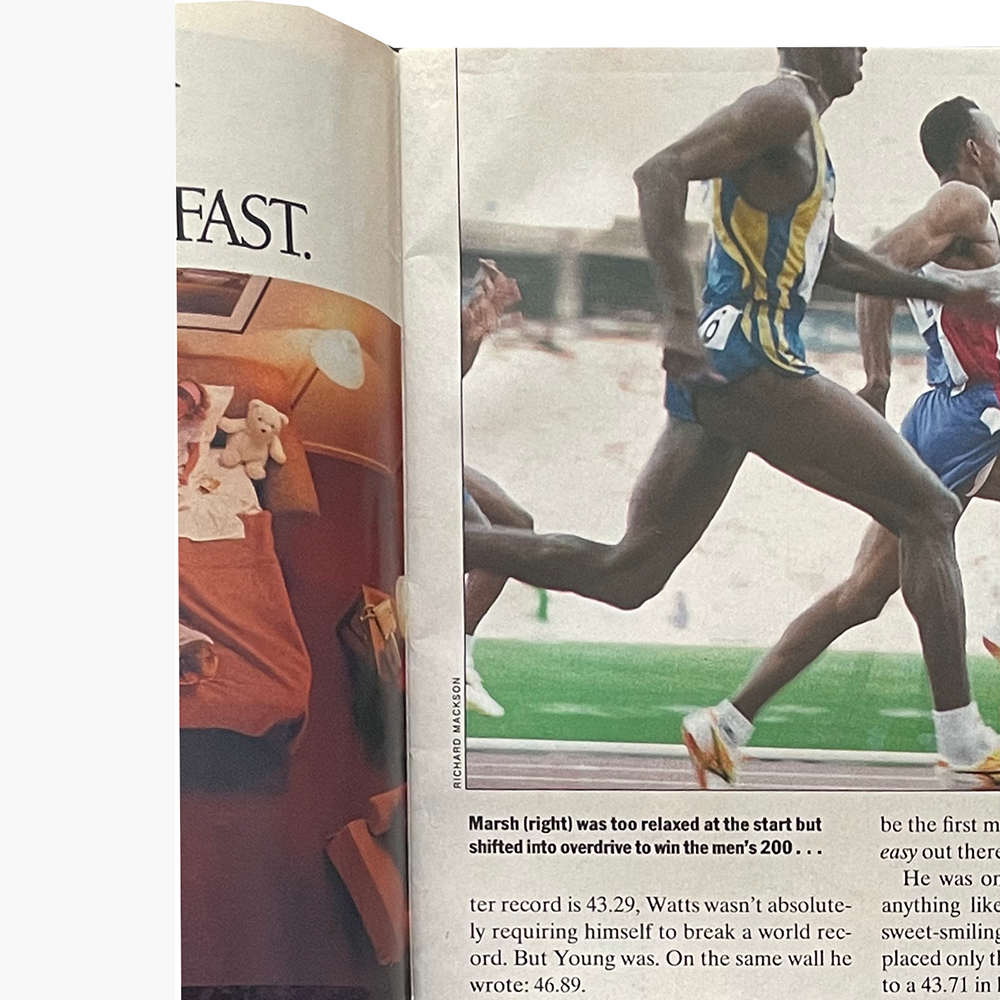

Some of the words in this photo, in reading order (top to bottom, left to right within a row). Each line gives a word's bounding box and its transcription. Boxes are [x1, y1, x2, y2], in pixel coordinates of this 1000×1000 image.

[452, 677, 461, 733] MACKSON
[453, 738, 462, 789] RICHARD
[469, 816, 519, 830] Marsh
[524, 816, 572, 833] (right)
[577, 820, 607, 831] was
[610, 817, 637, 831] too
[642, 817, 699, 831] relaxed
[704, 817, 720, 831] at
[723, 816, 749, 831] the
[754, 817, 792, 831] start
[796, 817, 822, 831] but
[469, 839, 523, 854] shifted
[527, 839, 556, 854] into
[561, 840, 633, 855] overdrive
[635, 841, 652, 855] to
[654, 840, 681, 855] win
[683, 840, 710, 855] the
[711, 840, 758, 855] men's
[759, 840, 793, 855] 200
[470, 979, 528, 993] wrote:
[534, 977, 585, 993] 46.89.
